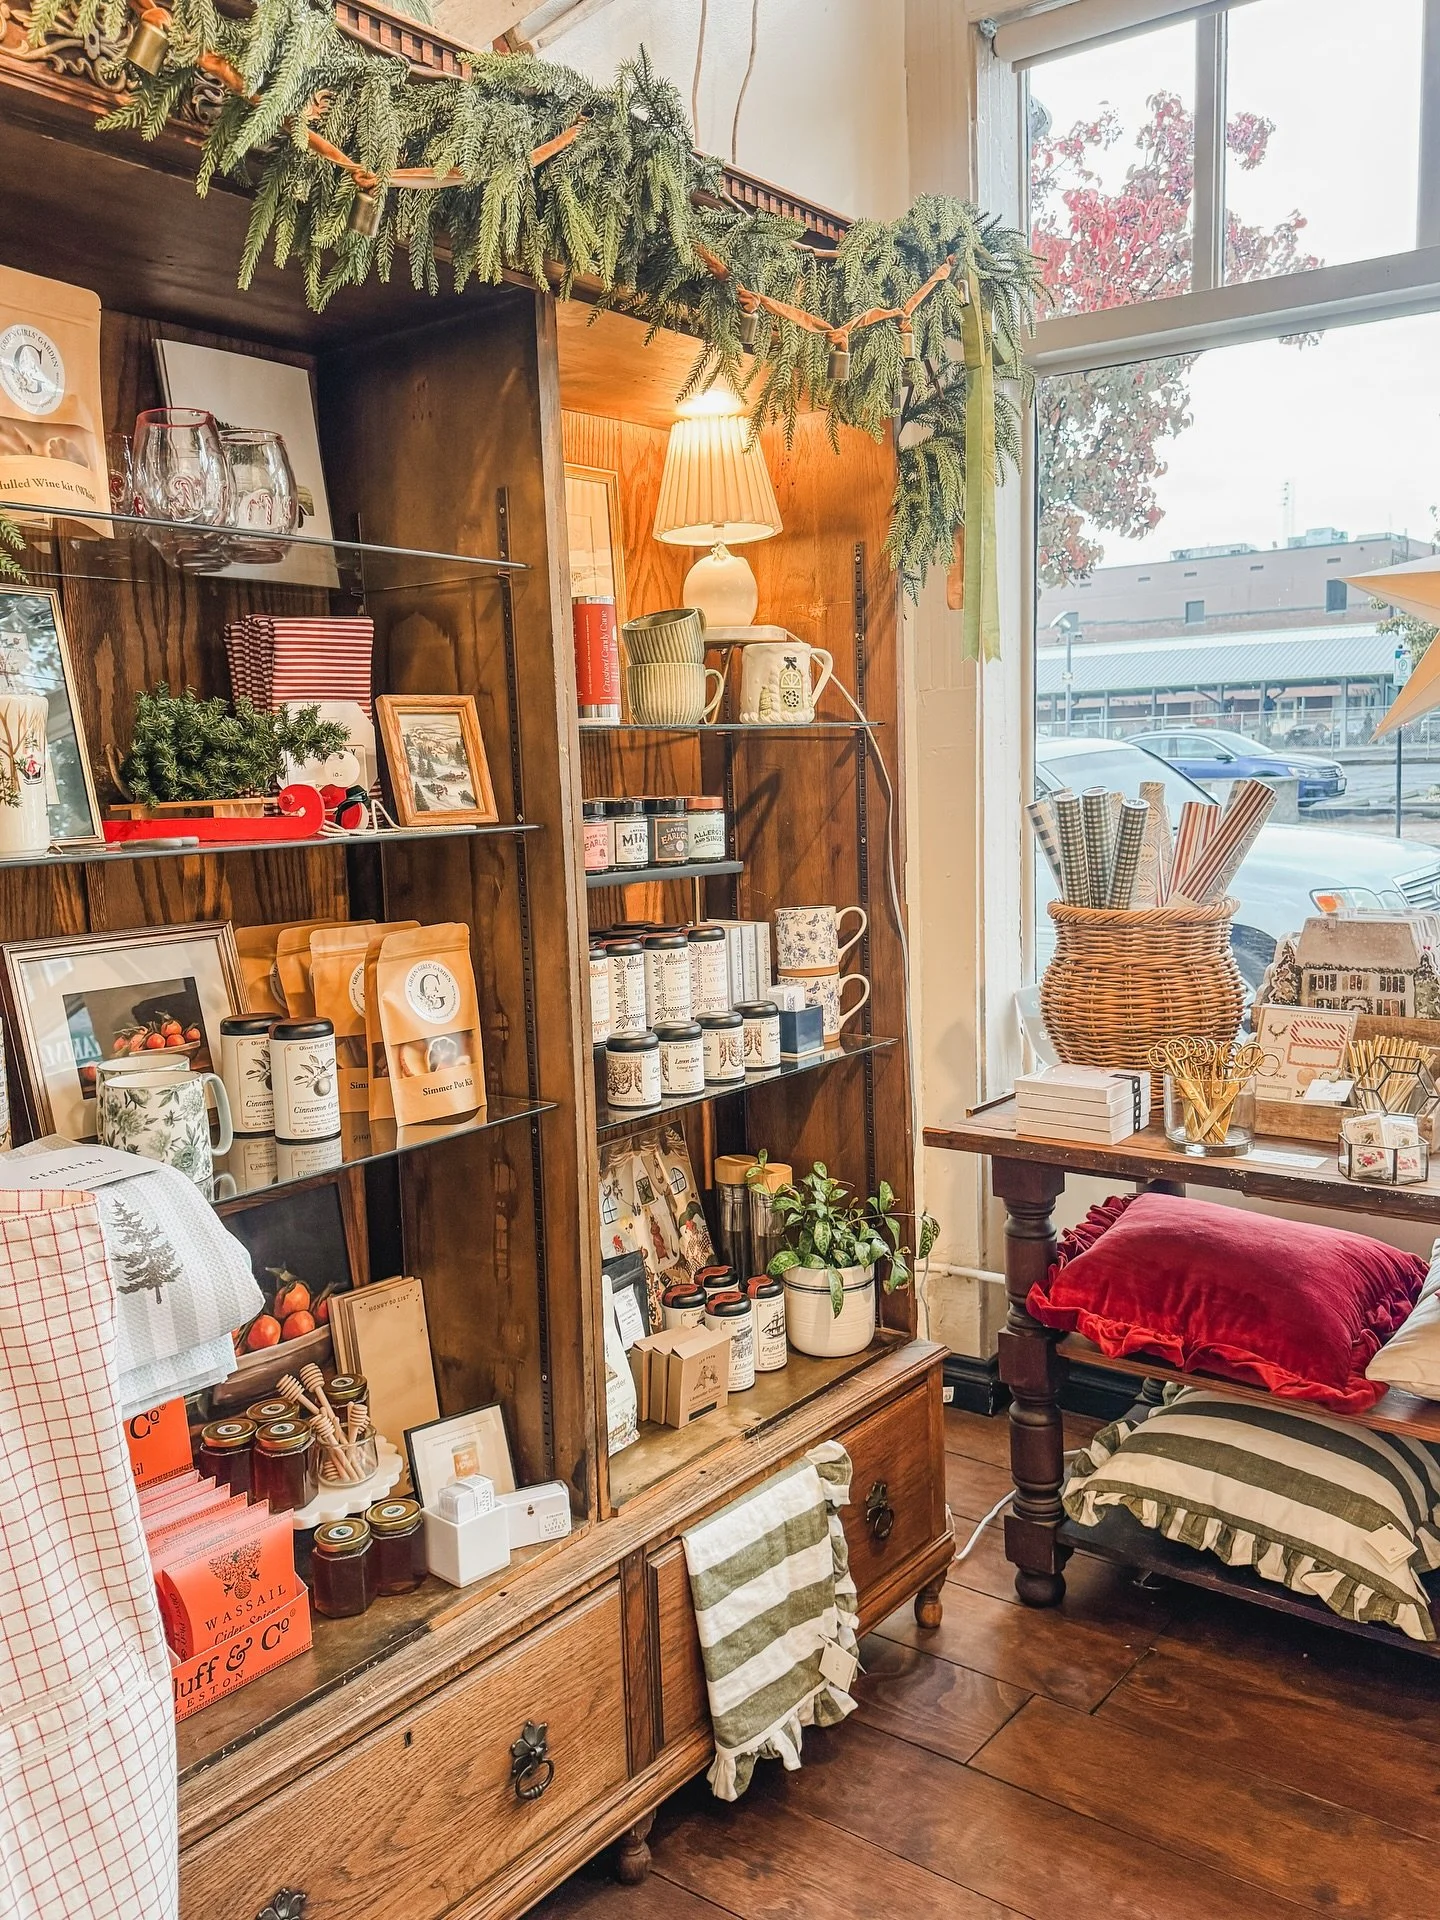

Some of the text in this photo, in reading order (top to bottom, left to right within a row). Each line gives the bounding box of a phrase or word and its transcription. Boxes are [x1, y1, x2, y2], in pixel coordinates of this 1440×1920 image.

[37, 336, 59, 368] GARDEN
[31, 477, 61, 489] Wine
[61, 480, 74, 492] kit
[600, 610, 608, 632] Cane
[600, 633, 609, 658] Candy
[600, 658, 611, 694] Crushed
[422, 1084, 453, 1097] Simmer
[453, 1080, 465, 1089] Pot
[293, 1104, 327, 1114] Cinnamon
[29, 1158, 104, 1180] GEOMETRY
[205, 1584, 287, 1632] WASSAIL
[214, 1624, 246, 1646] Cider
[173, 1655, 220, 1701] luff
[225, 1636, 253, 1672] &
[174, 1669, 244, 1714] LESTON
